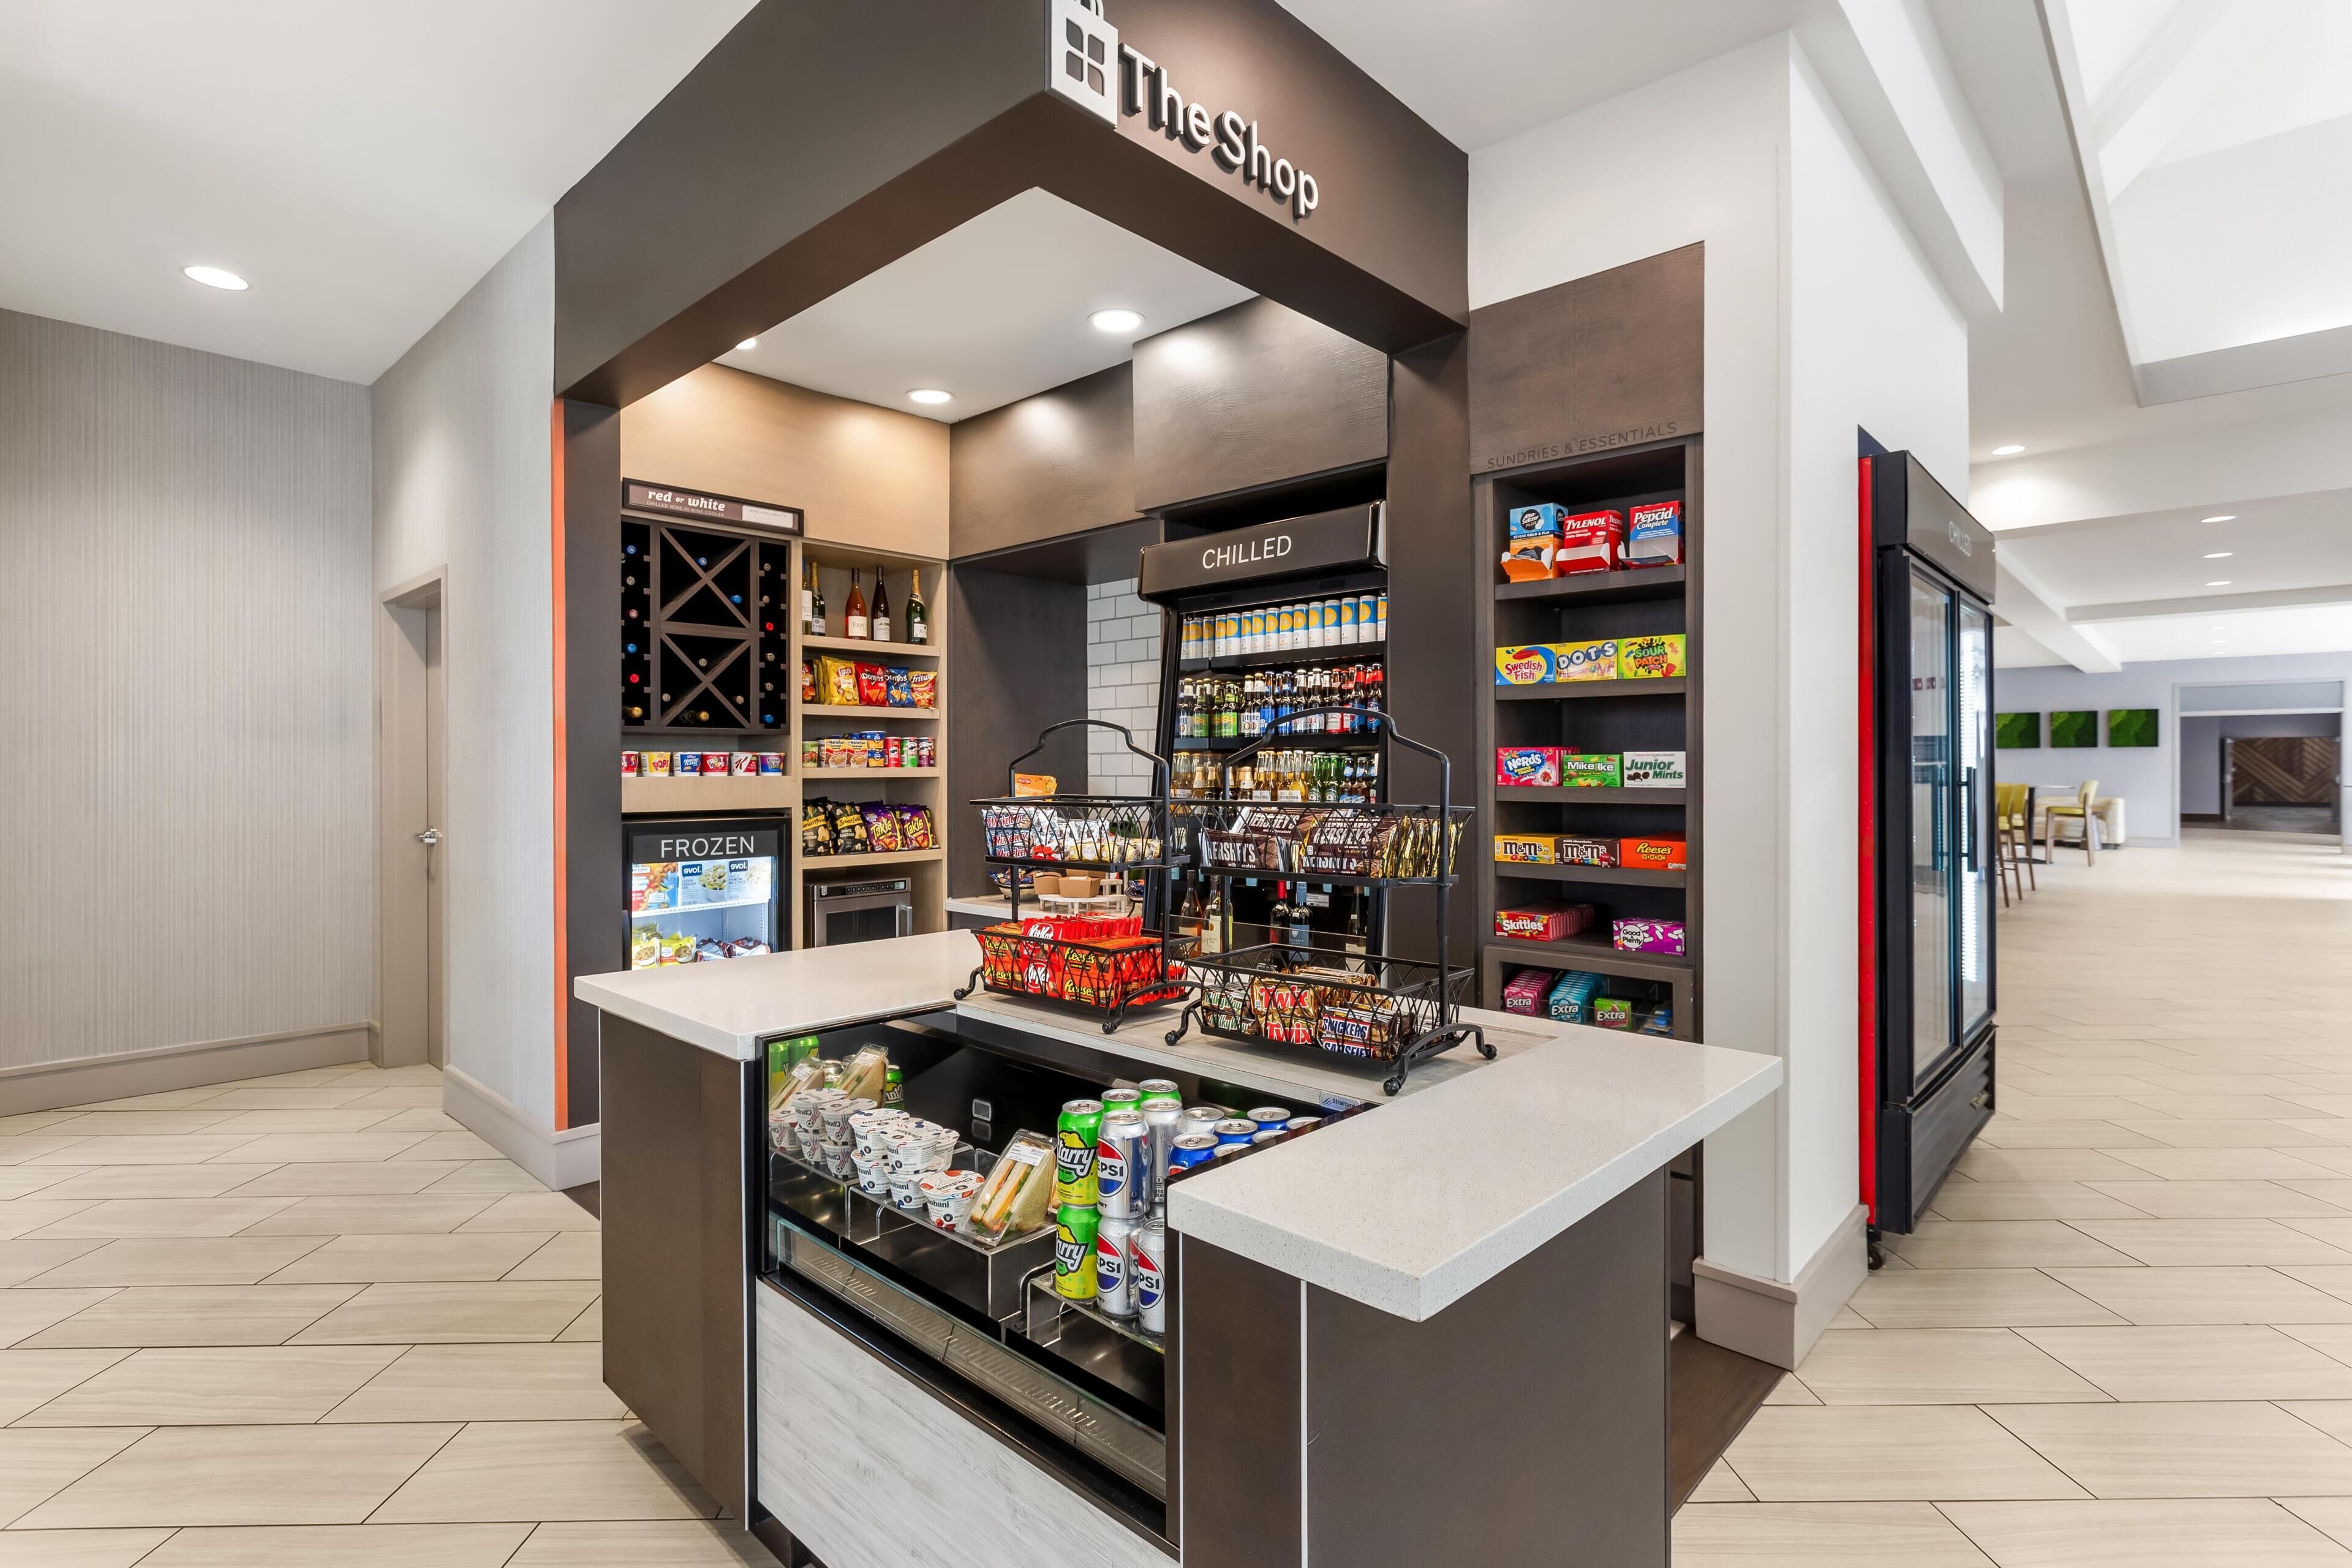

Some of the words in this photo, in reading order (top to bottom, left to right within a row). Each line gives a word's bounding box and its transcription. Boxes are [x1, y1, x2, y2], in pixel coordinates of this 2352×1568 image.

[1487, 445, 1559, 469] SUNDRIES
[1564, 442, 1574, 454] &
[1579, 421, 1677, 452] ESSENTIALS
[646, 500, 669, 509] CHILLED
[669, 503, 683, 511] WINE
[647, 490, 672, 503] red
[687, 497, 726, 511] white
[1634, 507, 1673, 524] Pepcid
[1566, 517, 1607, 531] TYLENOL
[1636, 519, 1669, 530] Complete
[1202, 535, 1292, 569] CHILLED
[1558, 643, 1616, 668] DOTS
[1635, 646, 1665, 658] SOUR
[1504, 660, 1544, 675] Swedish
[1635, 655, 1667, 669] PATCH
[860, 673, 884, 682] Doritos
[911, 674, 932, 683] Fritos
[1513, 669, 1536, 681] Fish
[652, 760, 669, 772] POPS
[1567, 761, 1595, 770] Mike
[1597, 763, 1615, 772] Ike
[1625, 759, 1674, 771] Junior
[1652, 770, 1684, 779] Mints
[870, 819, 892, 840] Takis
[904, 817, 924, 838] Takis
[661, 835, 755, 858] FROZEN
[1636, 842, 1673, 854] Reese's
[1502, 918, 1545, 931] Skittles
[1622, 937, 1643, 945] Plenty
[1506, 997, 1532, 1008] Extra
[1551, 1005, 1579, 1016] Extra
[1596, 1010, 1626, 1021] Extra
[1058, 1140, 1095, 1175] tarry
[1139, 1272, 1160, 1290] PSI
